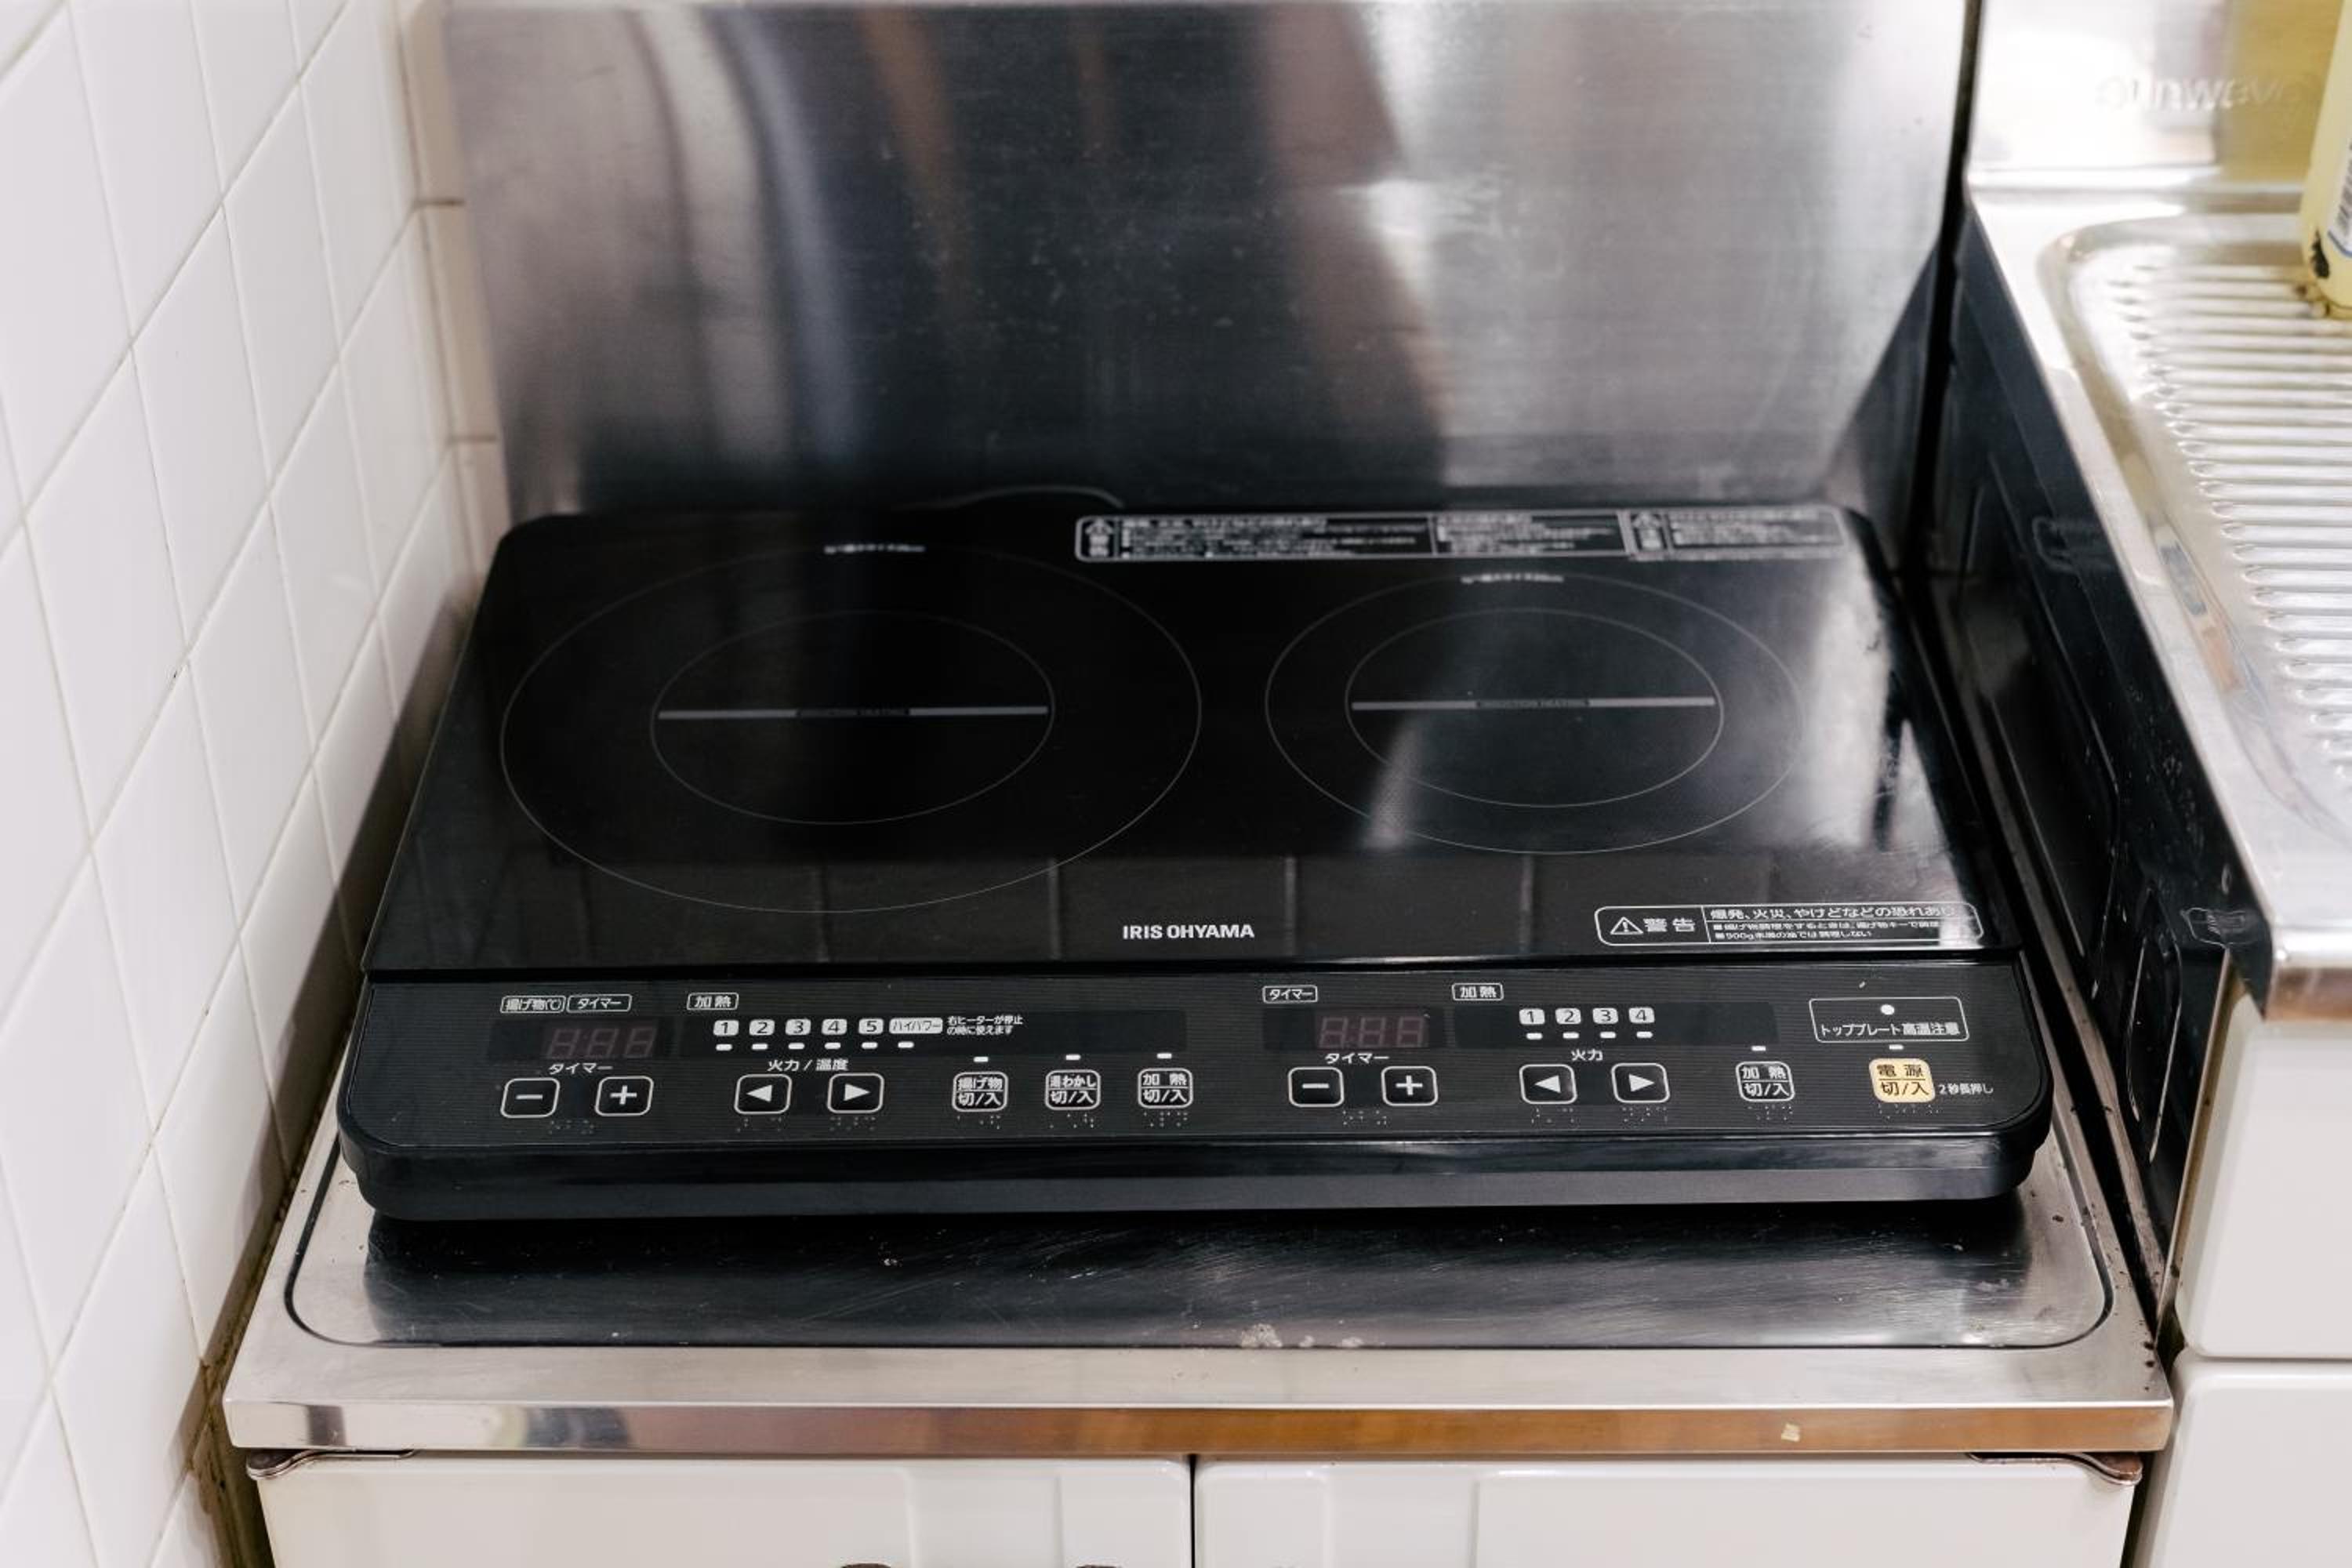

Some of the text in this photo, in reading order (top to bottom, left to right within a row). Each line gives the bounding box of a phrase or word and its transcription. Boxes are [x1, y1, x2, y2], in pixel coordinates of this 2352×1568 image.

[1123, 924, 1254, 939] IRIS OHYAMA
[1643, 917, 1695, 932] 警告
[1269, 988, 1314, 1001] タイマー
[1460, 985, 1497, 1000] 加熱
[578, 997, 622, 1009] タイマー
[695, 996, 731, 1008] 加熱
[1563, 1011, 1574, 1022] 2
[1600, 1010, 1611, 1022] 3
[1635, 1008, 1647, 1022] 4
[757, 1022, 768, 1034] 2
[793, 1022, 804, 1033] 3
[828, 1021, 840, 1033] 4
[866, 1021, 877, 1032] 5
[1820, 1022, 1961, 1036] トッププレート高温注意
[1325, 1052, 1389, 1065] タイマー
[1571, 1049, 1604, 1062] 火力
[549, 1062, 613, 1075] タイマー
[1741, 1065, 1788, 1080] 加熱
[1877, 1063, 1924, 1078] 電源
[957, 1076, 1003, 1091] 揚げ物
[1050, 1075, 1097, 1088] 湯わかし
[1142, 1073, 1187, 1087] 加熱
[1142, 1089, 1187, 1103] 切/入
[1744, 1082, 1790, 1098] 切/入
[1881, 1082, 1929, 1097] 切/入
[1939, 1083, 1994, 1095] 2秒長押し
[958, 1093, 1001, 1106] 切/入
[1051, 1091, 1094, 1105] 切/入
